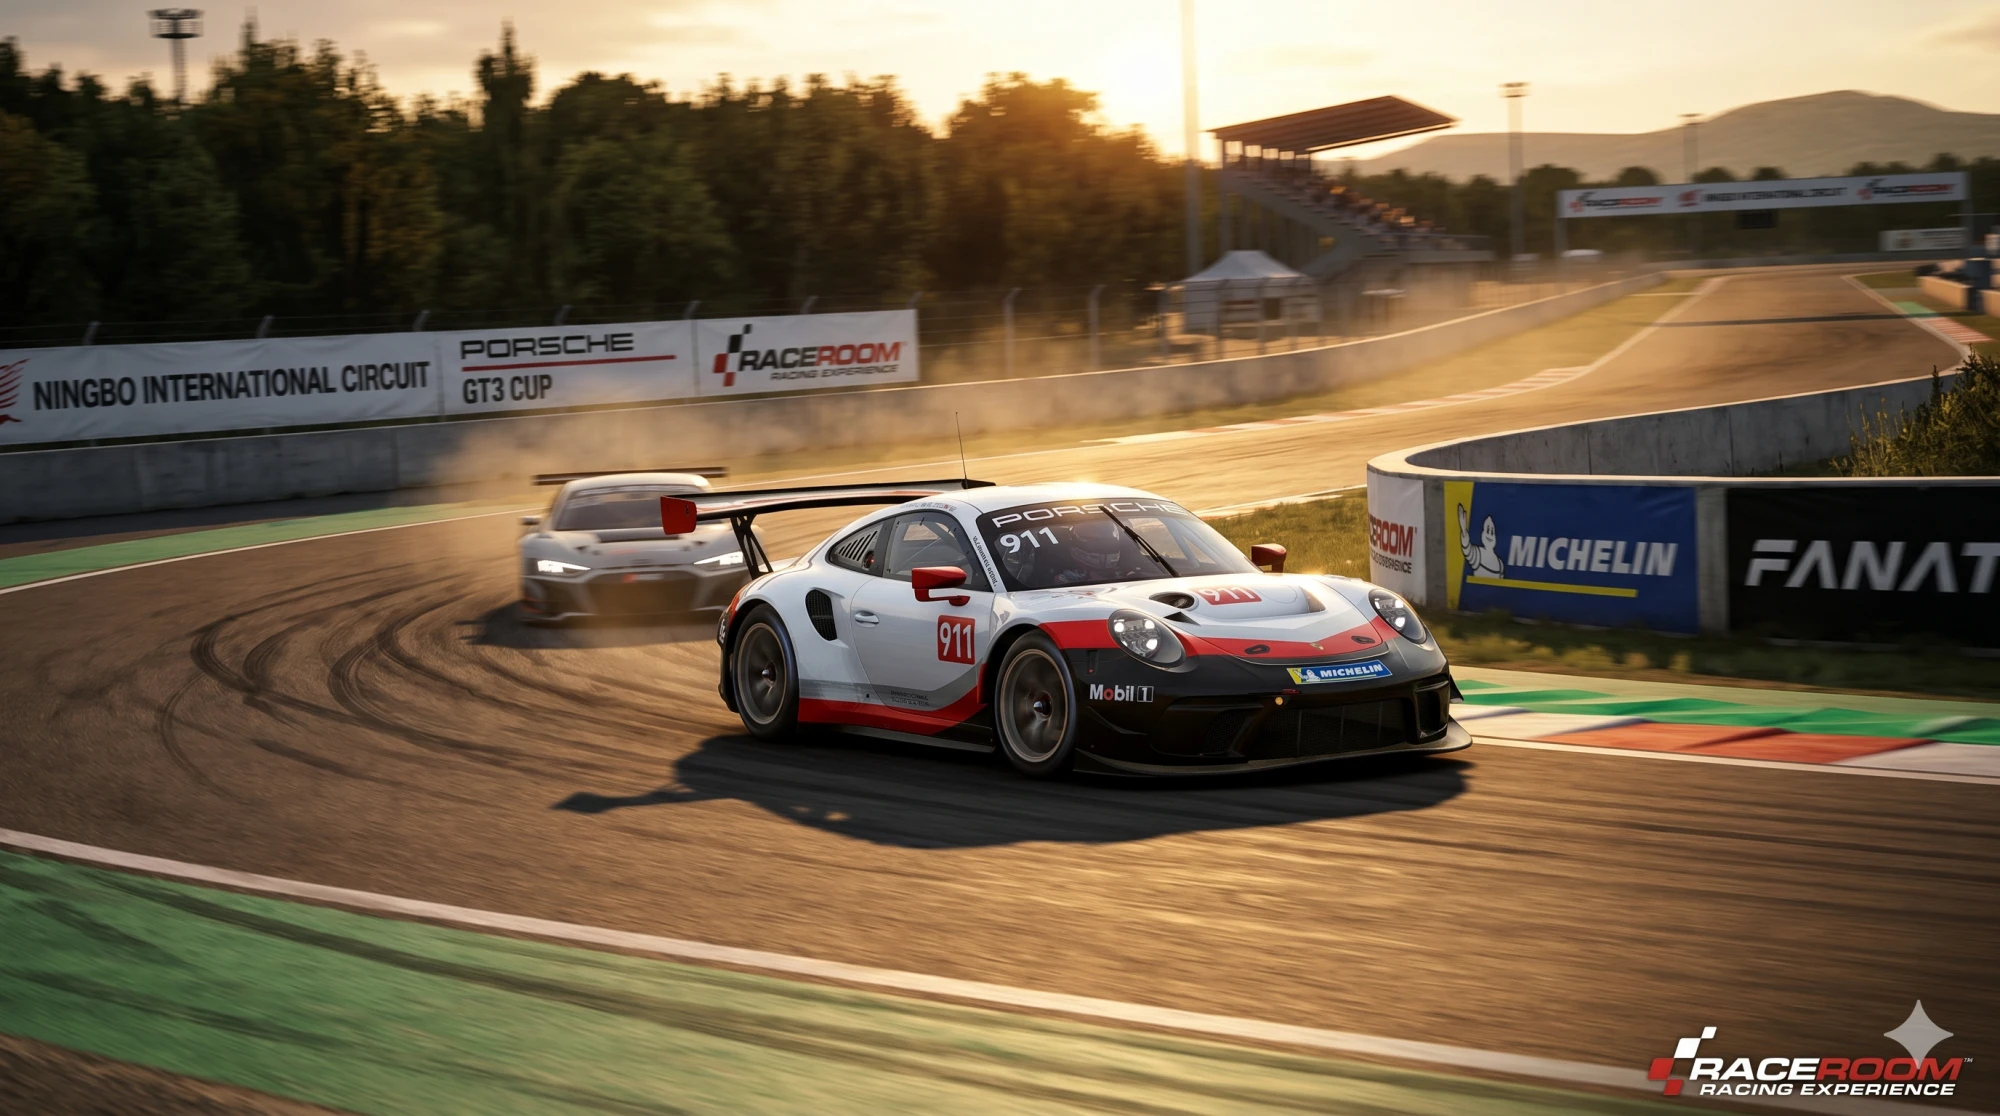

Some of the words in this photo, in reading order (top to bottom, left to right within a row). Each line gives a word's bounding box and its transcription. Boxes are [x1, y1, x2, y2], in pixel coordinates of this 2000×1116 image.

[460, 332, 634, 360] PORSCHE
[738, 341, 902, 371] RACEROOM
[33, 376, 137, 411] NINGBO
[142, 366, 337, 404] INTERNATIONAL
[341, 361, 430, 393] CIRCUIT
[770, 370, 818, 381] RACING
[821, 364, 899, 379] EXPERIENCE
[463, 376, 505, 404] GT3
[510, 374, 553, 401] CUP
[991, 502, 1188, 528] PORSCHE
[1000, 526, 1059, 554] 911
[1507, 535, 1679, 577] MICHELIN
[1198, 586, 1256, 602] 911
[940, 622, 973, 659] 911
[1320, 664, 1384, 678] MICHELIN
[1089, 683, 1135, 702] Mobil
